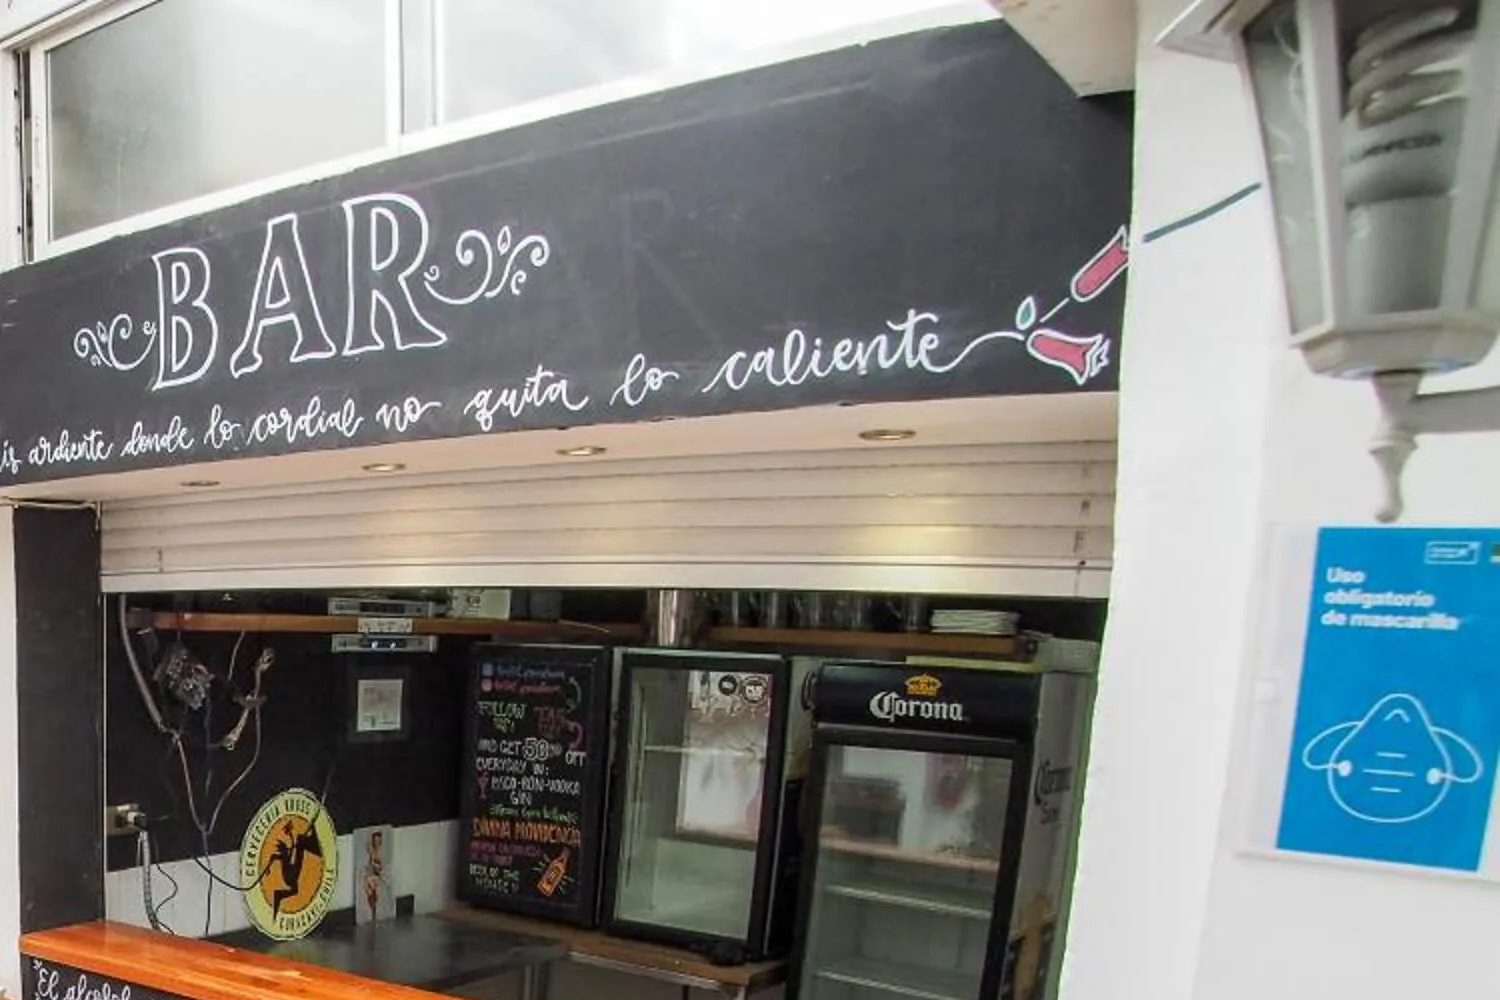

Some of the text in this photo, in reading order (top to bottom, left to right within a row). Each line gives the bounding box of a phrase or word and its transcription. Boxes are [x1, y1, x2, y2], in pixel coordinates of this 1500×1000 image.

[151, 192, 449, 392] BAR
[28, 429, 114, 465] ardiente
[120, 415, 195, 457] donde
[204, 404, 241, 448] lo
[246, 396, 366, 444] cordial
[376, 396, 442, 432] no
[463, 363, 589, 432] quita
[610, 353, 680, 407] lo
[702, 308, 960, 393] caliente
[1326, 566, 1366, 584] Uso
[1324, 588, 1436, 609] obligatorio
[1320, 610, 1461, 631] de mascarilla
[870, 691, 964, 723] Corona
[37, 967, 59, 1000] El
